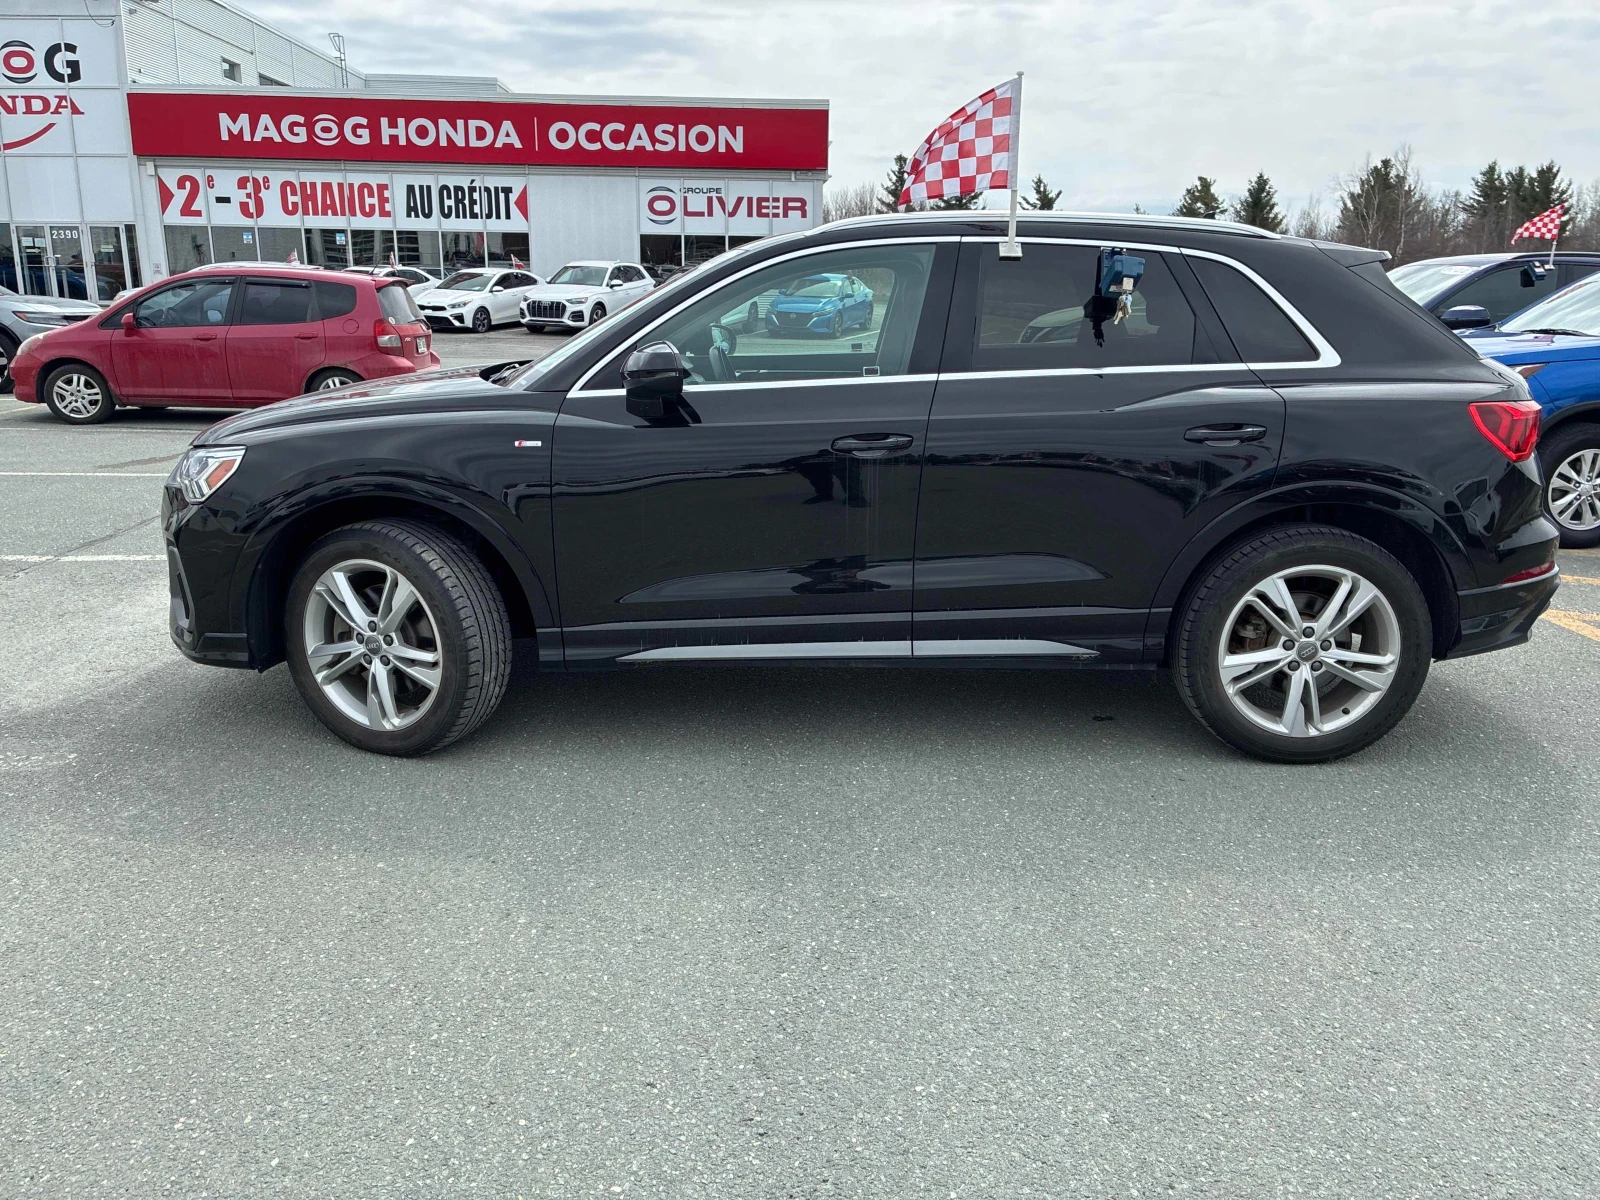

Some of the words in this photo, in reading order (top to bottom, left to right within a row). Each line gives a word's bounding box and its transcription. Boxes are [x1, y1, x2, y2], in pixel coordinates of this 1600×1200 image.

[218, 112, 371, 146] MAGOG
[380, 117, 523, 149] HONDA
[548, 121, 744, 153] OCCASION
[279, 180, 392, 218] CHANCE
[405, 184, 433, 219] AU
[438, 178, 513, 220] CRÉDIT
[679, 187, 722, 195] GROUPE
[647, 194, 808, 219] OLIVIER
[52, 230, 79, 239] 2390
